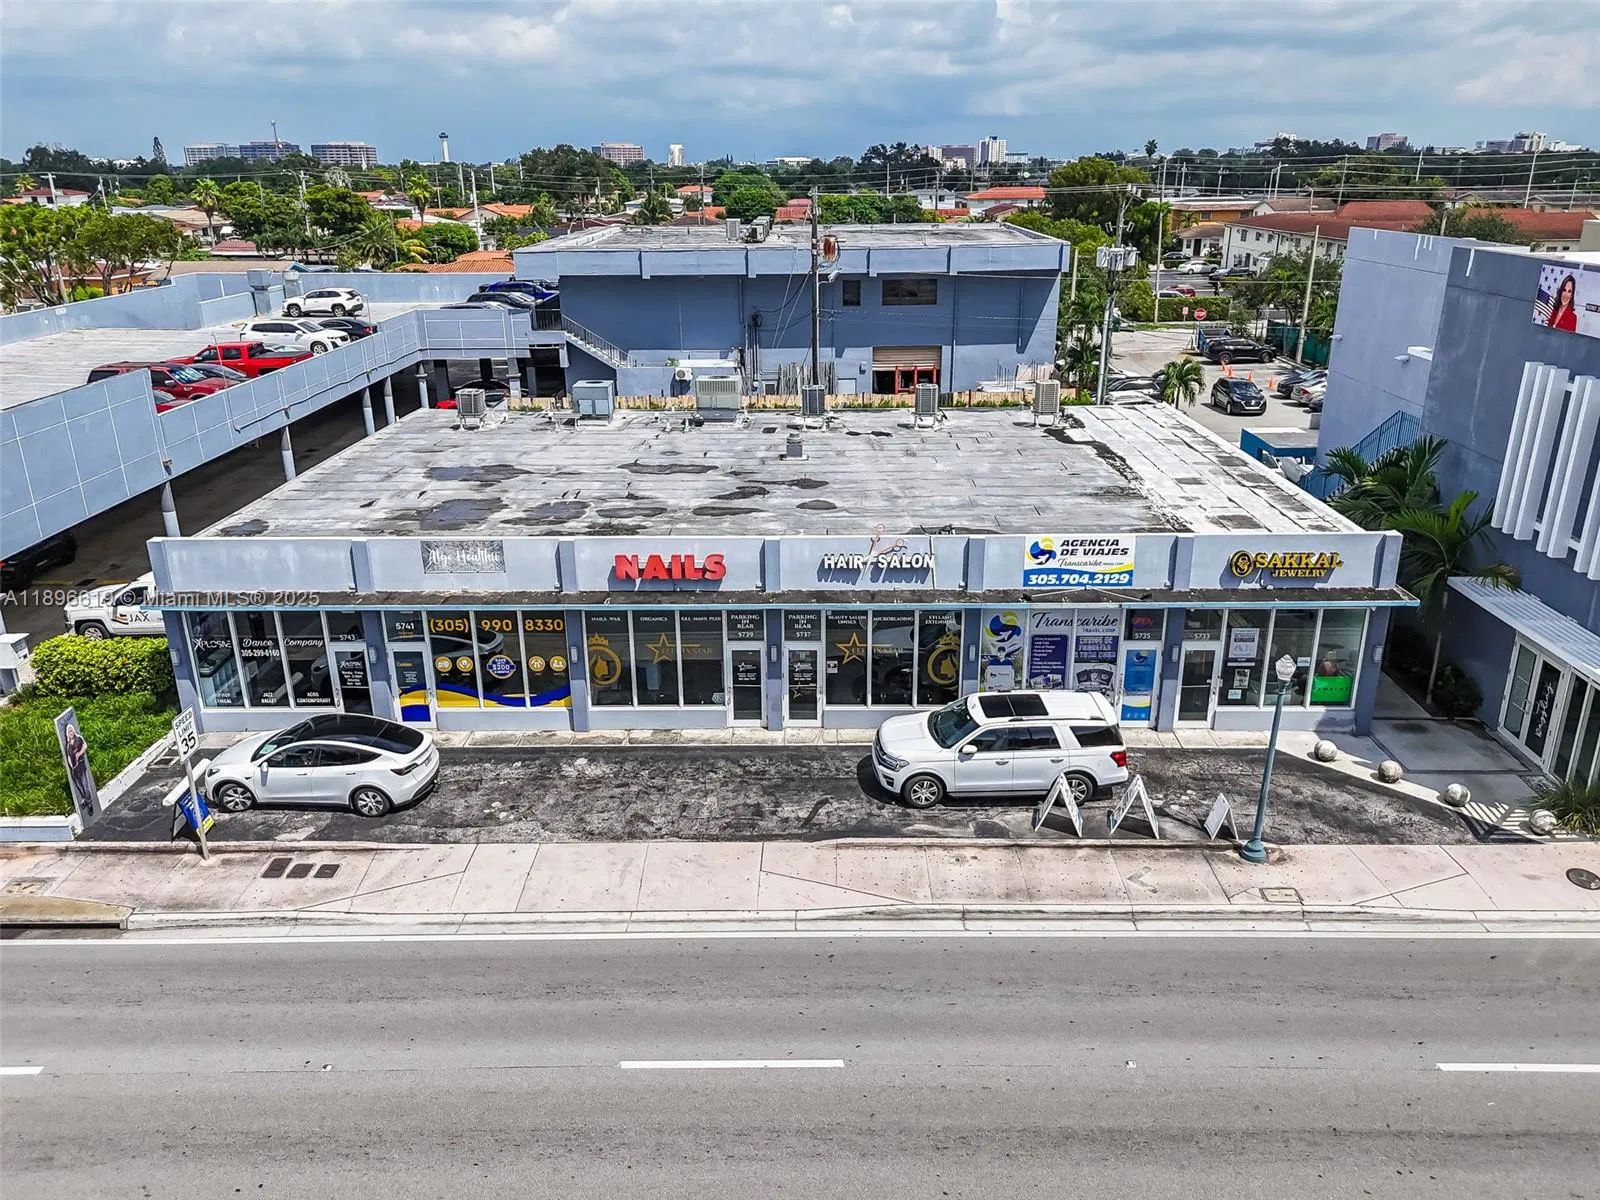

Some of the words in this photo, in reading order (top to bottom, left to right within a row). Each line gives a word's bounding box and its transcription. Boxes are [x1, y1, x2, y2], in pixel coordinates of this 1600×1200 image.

[1060, 539, 1119, 547] AGENCIA
[1060, 548, 1078, 556] DE
[1083, 548, 1129, 556] VIAJES
[614, 554, 727, 581] NAILS
[823, 553, 864, 569] HAIR
[877, 552, 935, 569] SALON
[1255, 552, 1344, 568] SAKKAL
[1028, 574, 1130, 584] 305.704.2129
[1272, 569, 1327, 577] JEWELRY
[129, 611, 150, 622] JAX
[1032, 611, 1119, 628] Transcaribe
[430, 618, 469, 633] (305)
[481, 619, 512, 631] 990
[525, 619, 564, 631] 8330
[242, 638, 274, 647] Dance
[284, 638, 324, 648] Company
[174, 710, 193, 730] SPEED
[178, 723, 193, 738] LIMIT
[180, 732, 196, 755] 35
